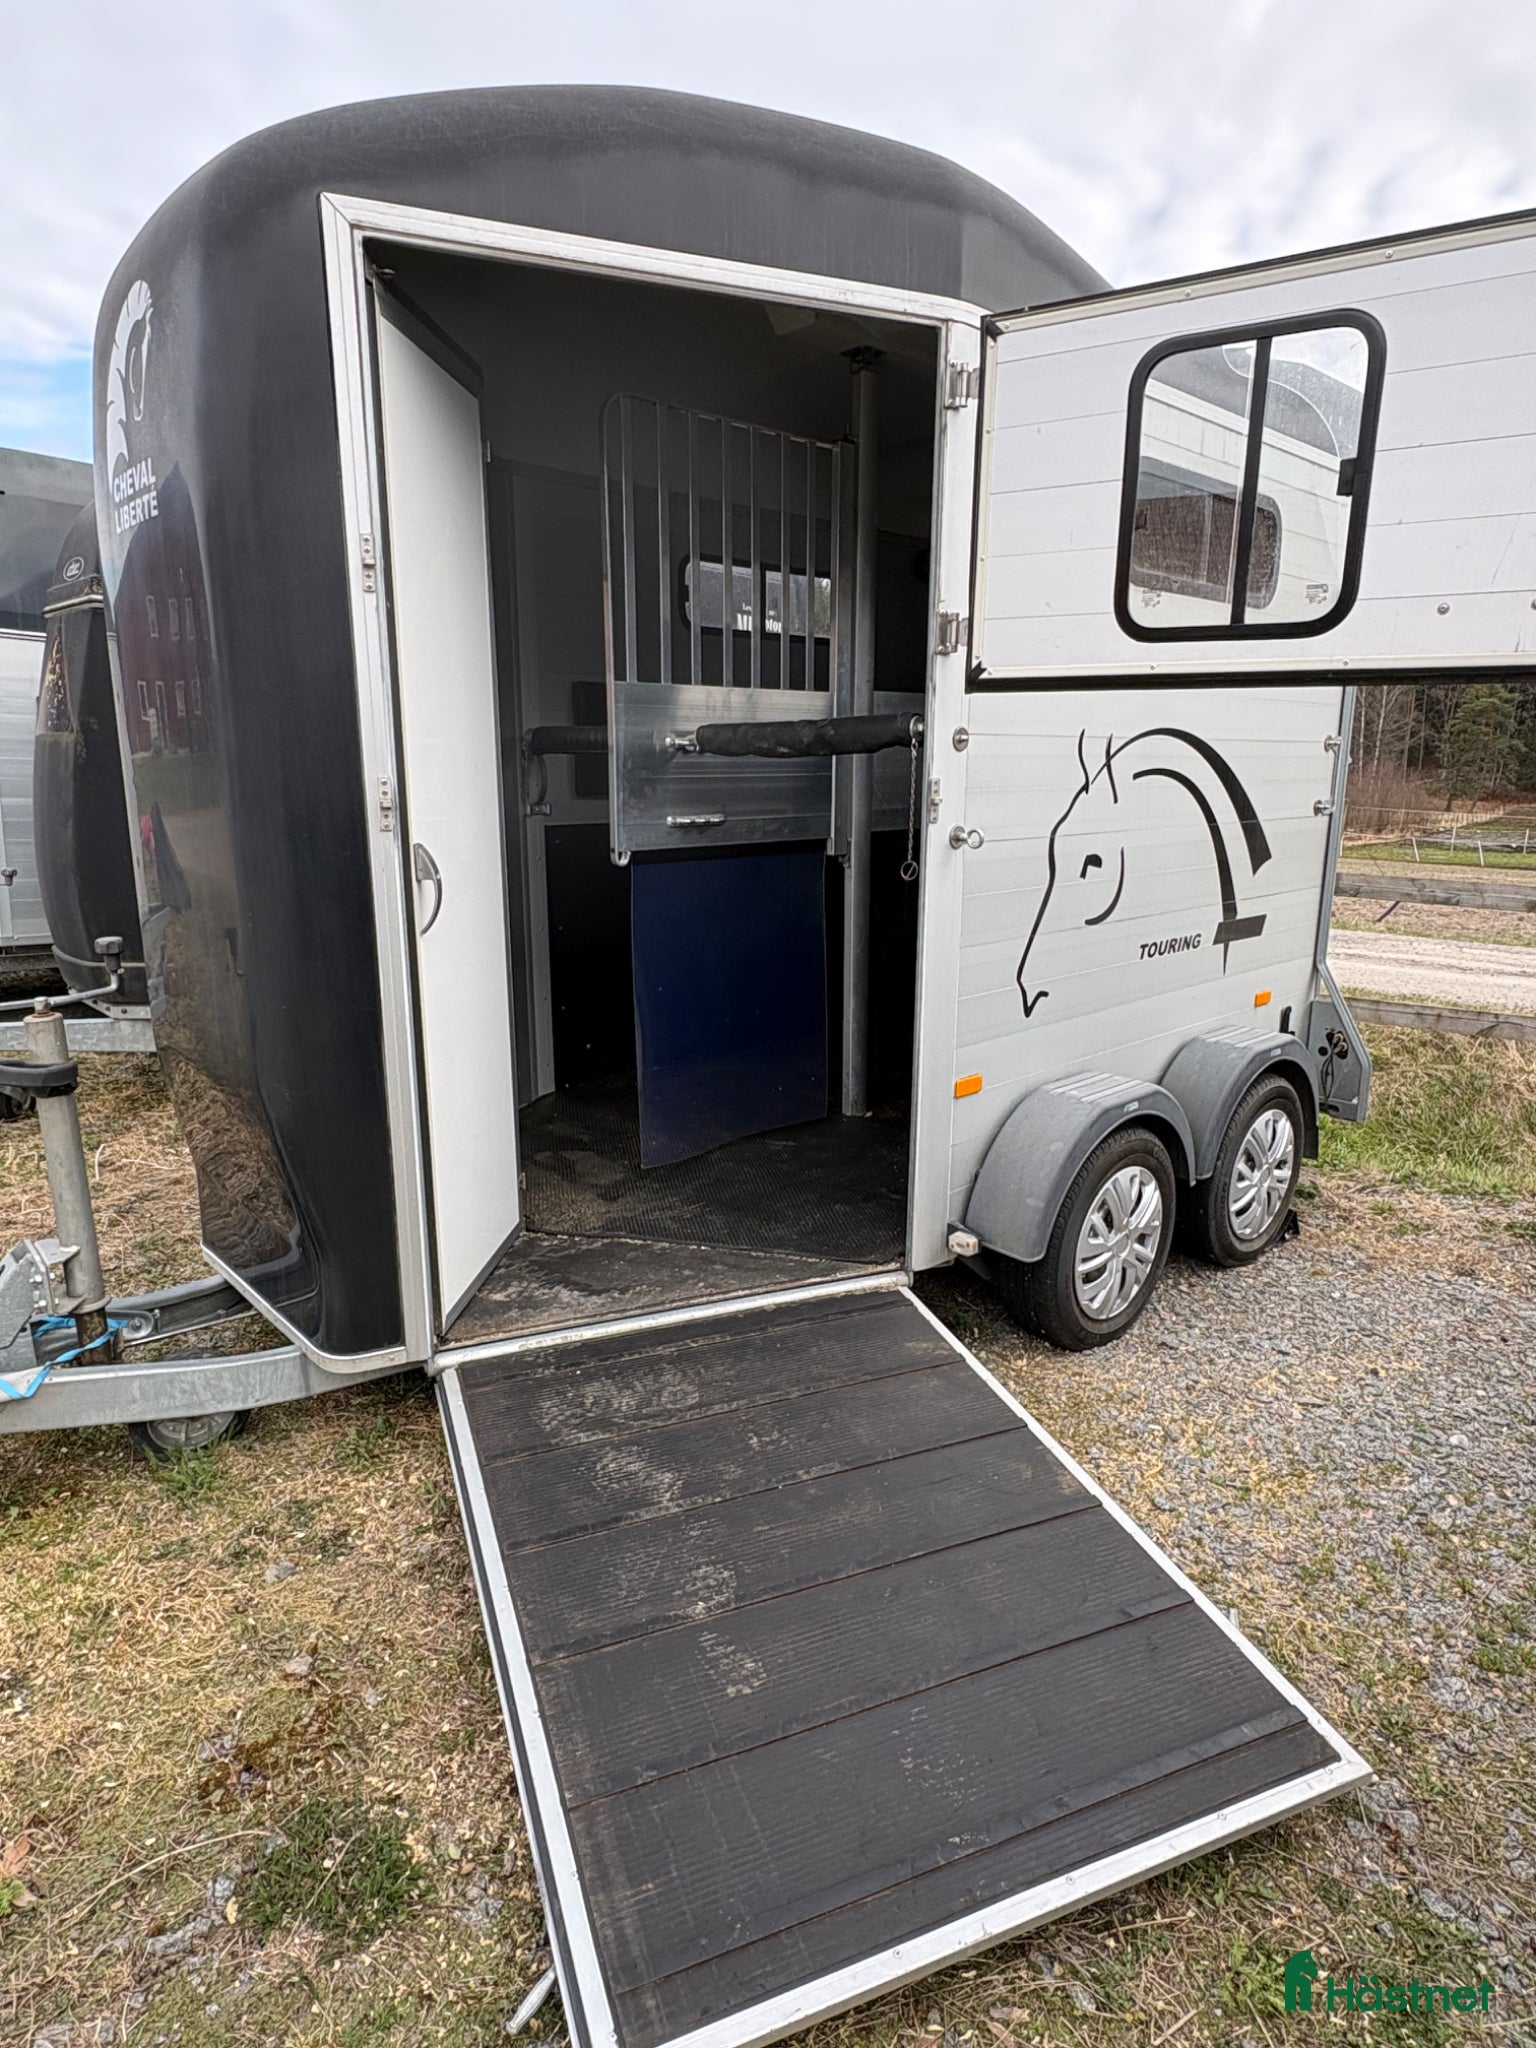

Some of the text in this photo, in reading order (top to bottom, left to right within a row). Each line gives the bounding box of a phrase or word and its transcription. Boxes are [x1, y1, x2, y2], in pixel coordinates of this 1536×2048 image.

[114, 457, 156, 503] CHEVAL
[115, 484, 159, 534] LIBERTÉ
[1139, 933, 1202, 960] TOURING
